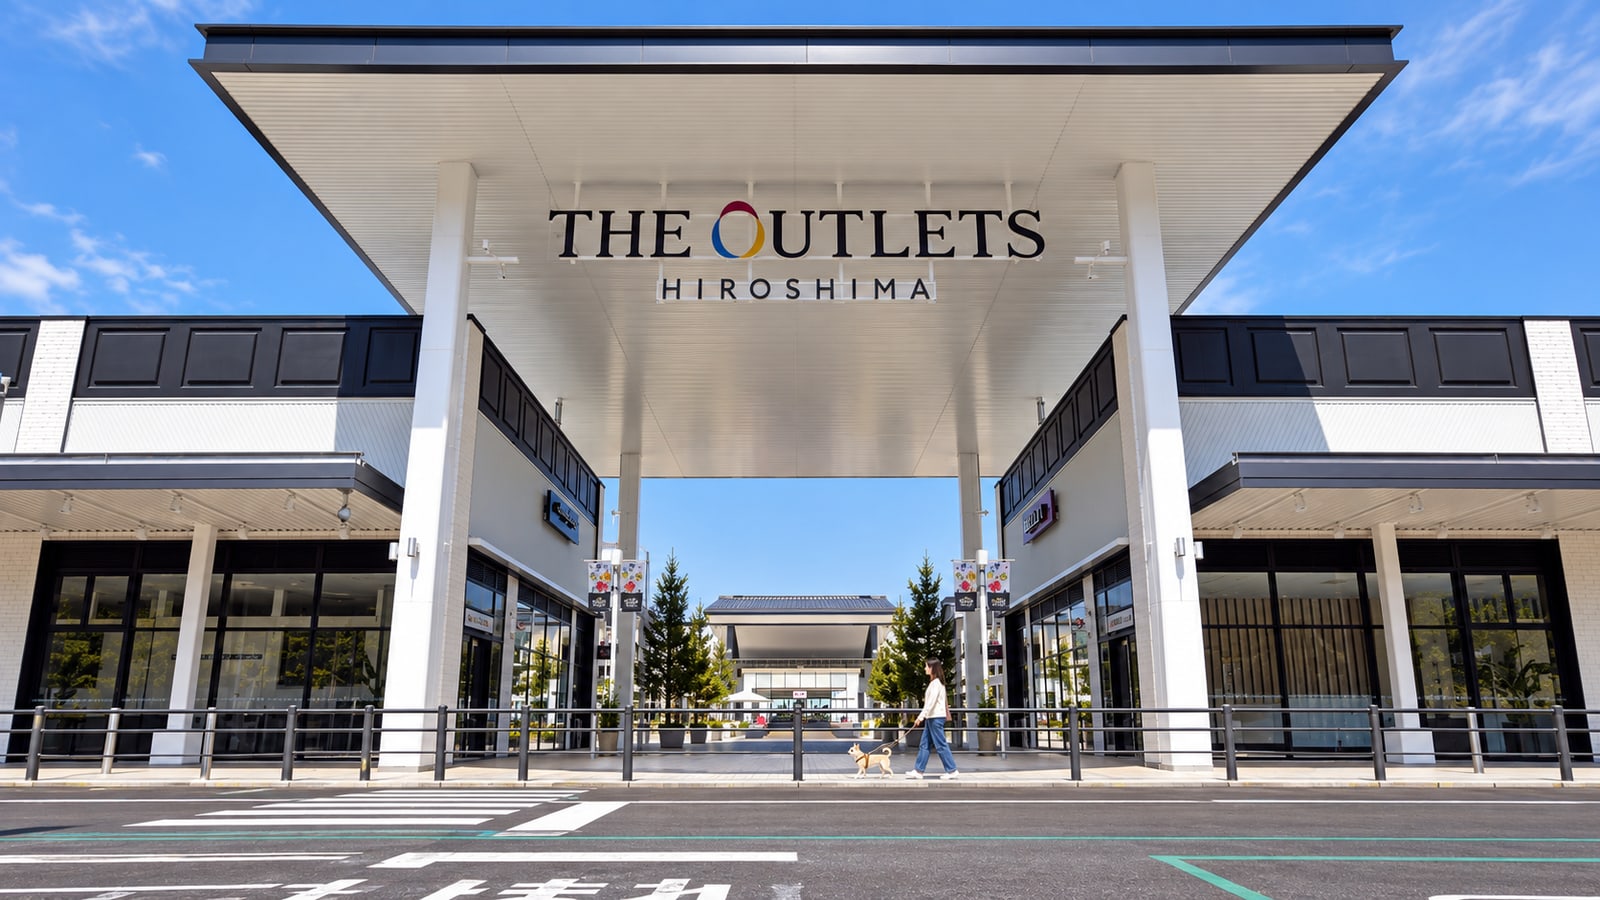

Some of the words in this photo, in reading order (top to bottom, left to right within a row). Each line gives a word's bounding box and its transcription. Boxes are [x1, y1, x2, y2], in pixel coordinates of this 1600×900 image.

[549, 209, 691, 258] THE
[711, 200, 1046, 258] OUTLETS
[662, 278, 930, 300] HIROSHIMA
